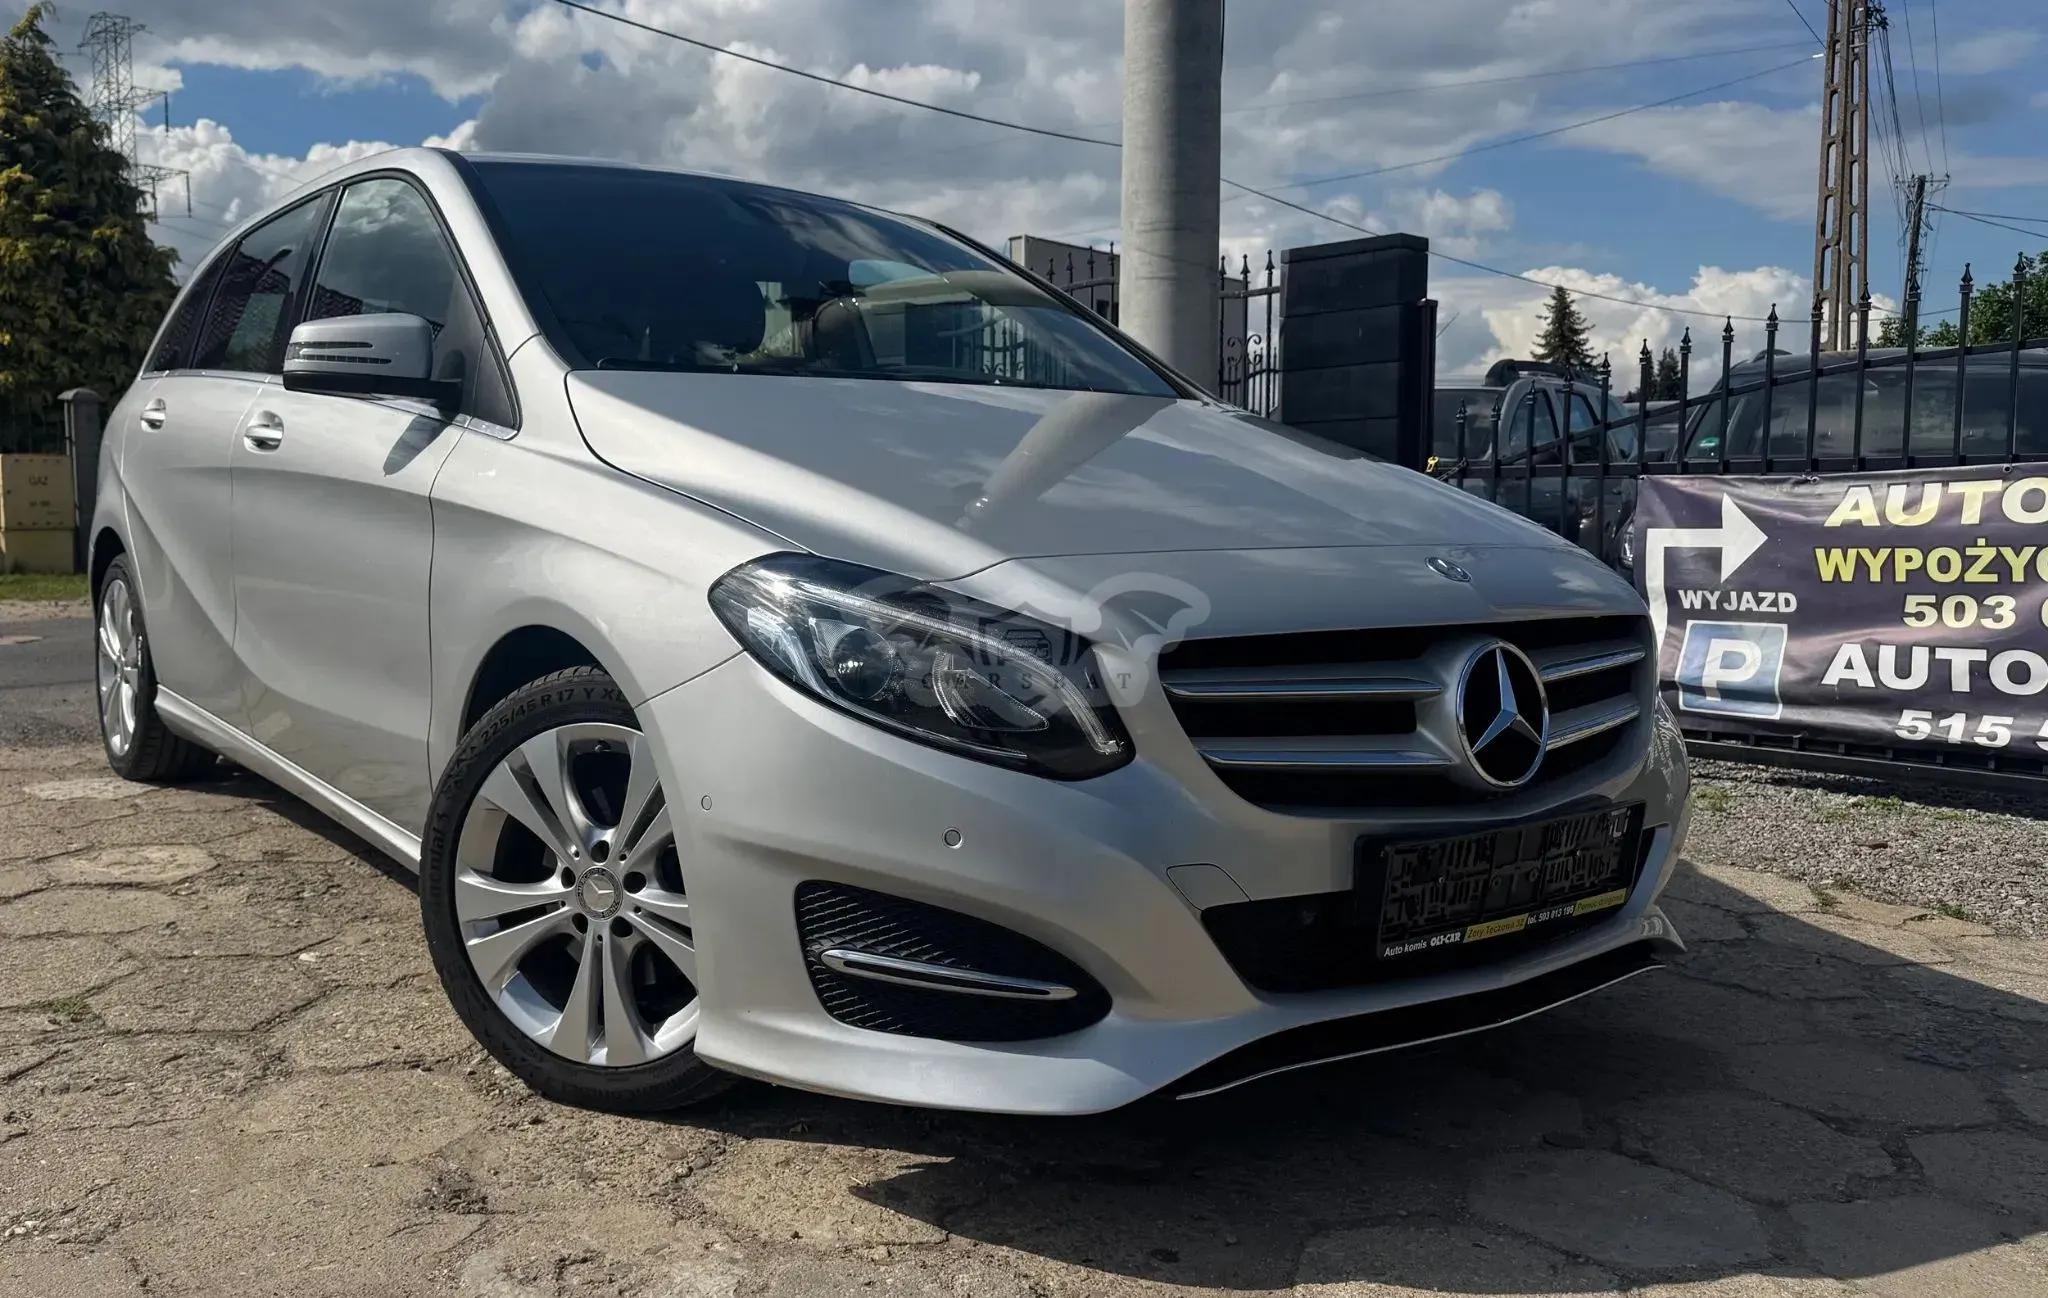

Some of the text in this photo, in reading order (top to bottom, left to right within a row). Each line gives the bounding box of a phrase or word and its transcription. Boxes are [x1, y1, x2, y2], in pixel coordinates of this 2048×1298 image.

[1823, 477, 2048, 527] AUTO
[1678, 589, 1797, 613] WYJAZD
[1903, 594, 2016, 629] 503
[1702, 638, 1762, 702] P
[1821, 643, 2048, 696] AUTO
[481, 699, 536, 744] 225/45
[1895, 709, 2014, 748] 515
[1404, 940, 1427, 953] komis
